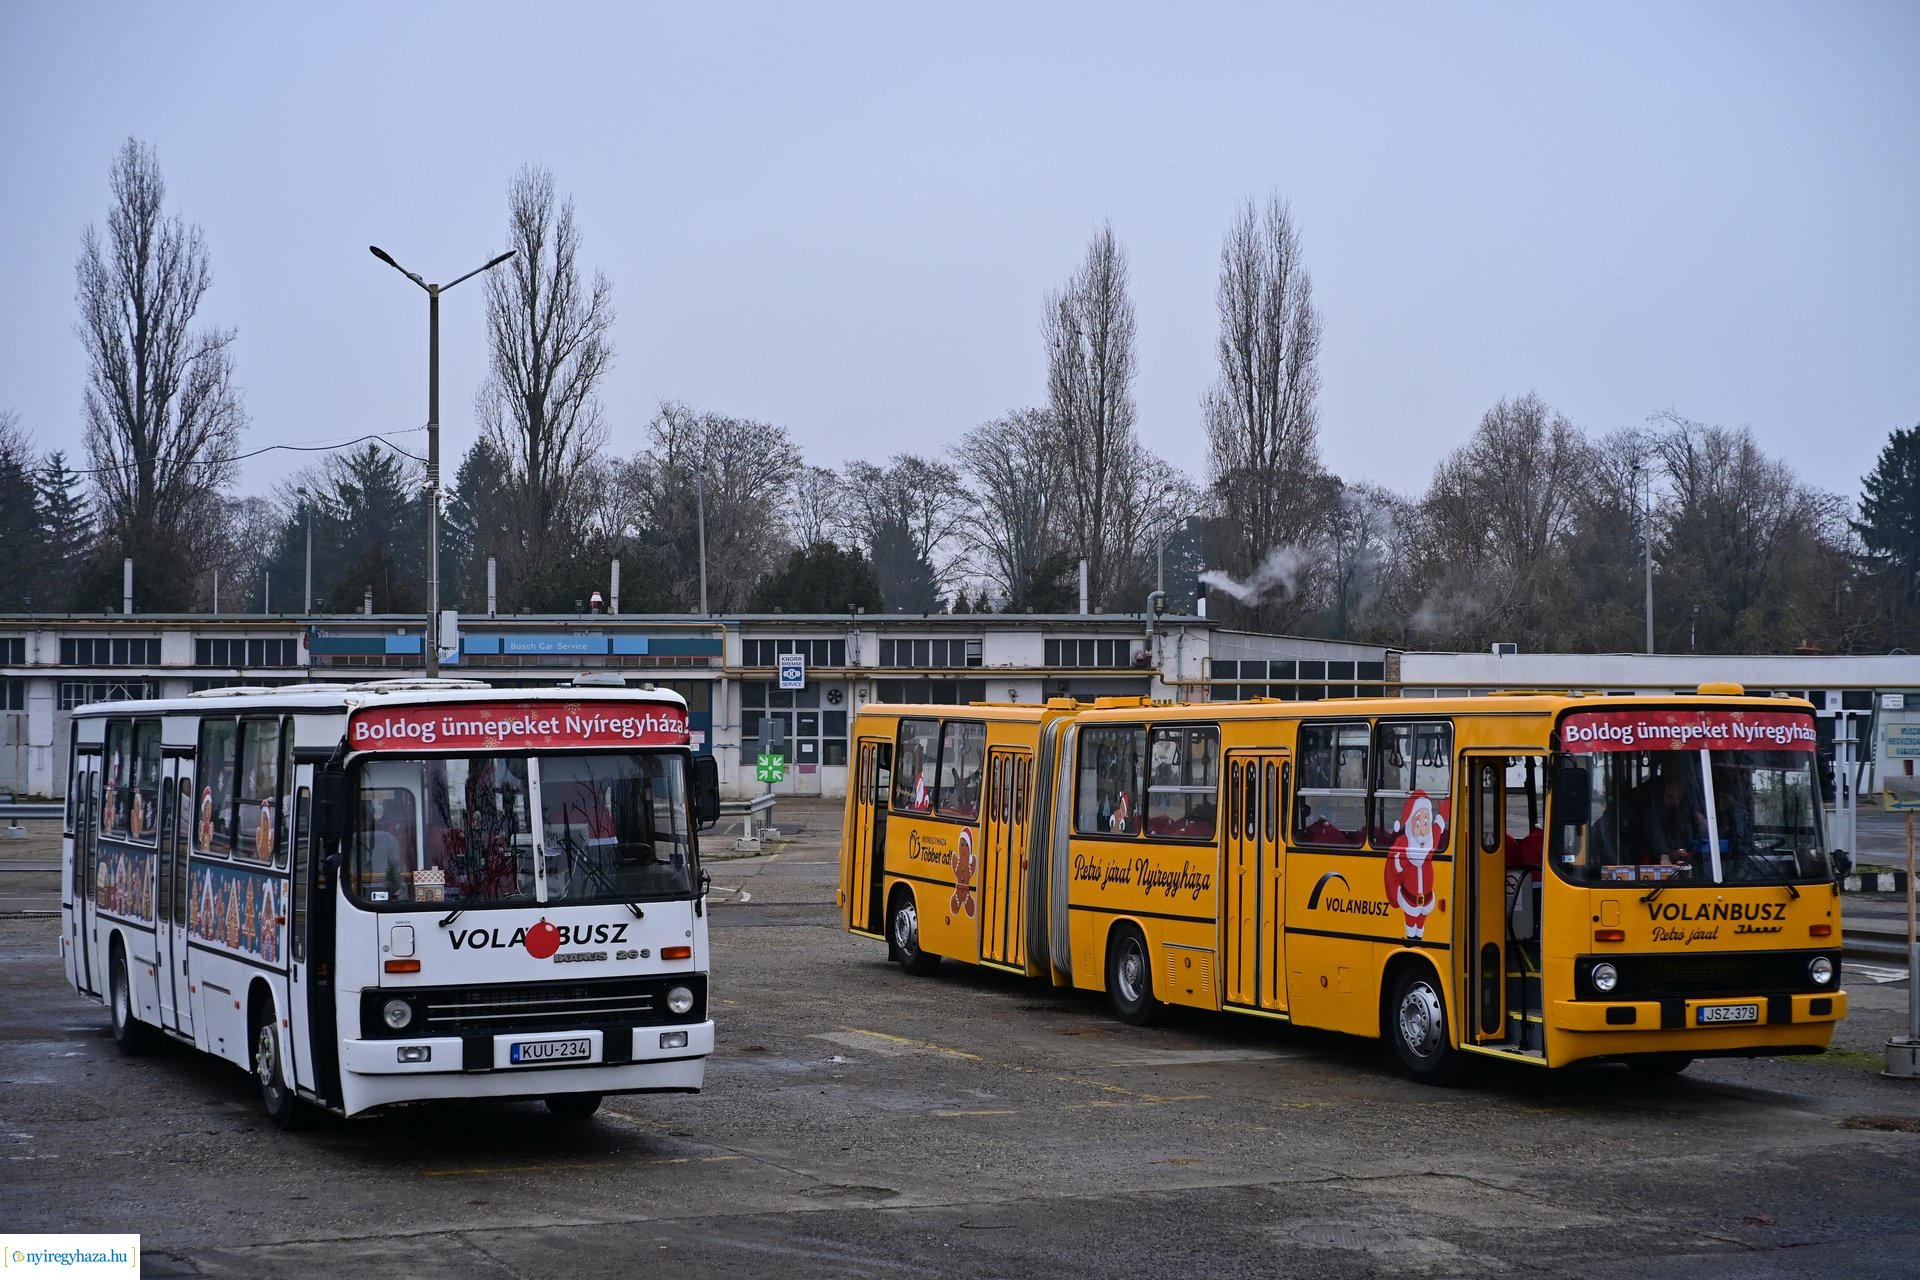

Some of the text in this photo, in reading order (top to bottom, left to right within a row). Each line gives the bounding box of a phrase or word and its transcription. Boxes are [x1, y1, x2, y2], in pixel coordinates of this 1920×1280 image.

[510, 642, 587, 650] Bosch Car Service
[355, 718, 437, 743] Boldog
[441, 716, 560, 741] ünnepeket
[566, 714, 690, 739] Nyíregyháza!
[1565, 722, 1634, 743] Boldog
[1638, 720, 1730, 743] ünnepeket
[1074, 854, 1211, 900] Retró járat Nyíregyháza
[1326, 897, 1389, 917] VOLÁNBUSZ
[1647, 903, 1787, 921] VOLÁNBUSZ
[1652, 926, 1719, 945] Retró járat
[554, 951, 608, 963] IKARUS
[1706, 1007, 1755, 1020] JSZ-379
[522, 1042, 587, 1059] KUU-234
